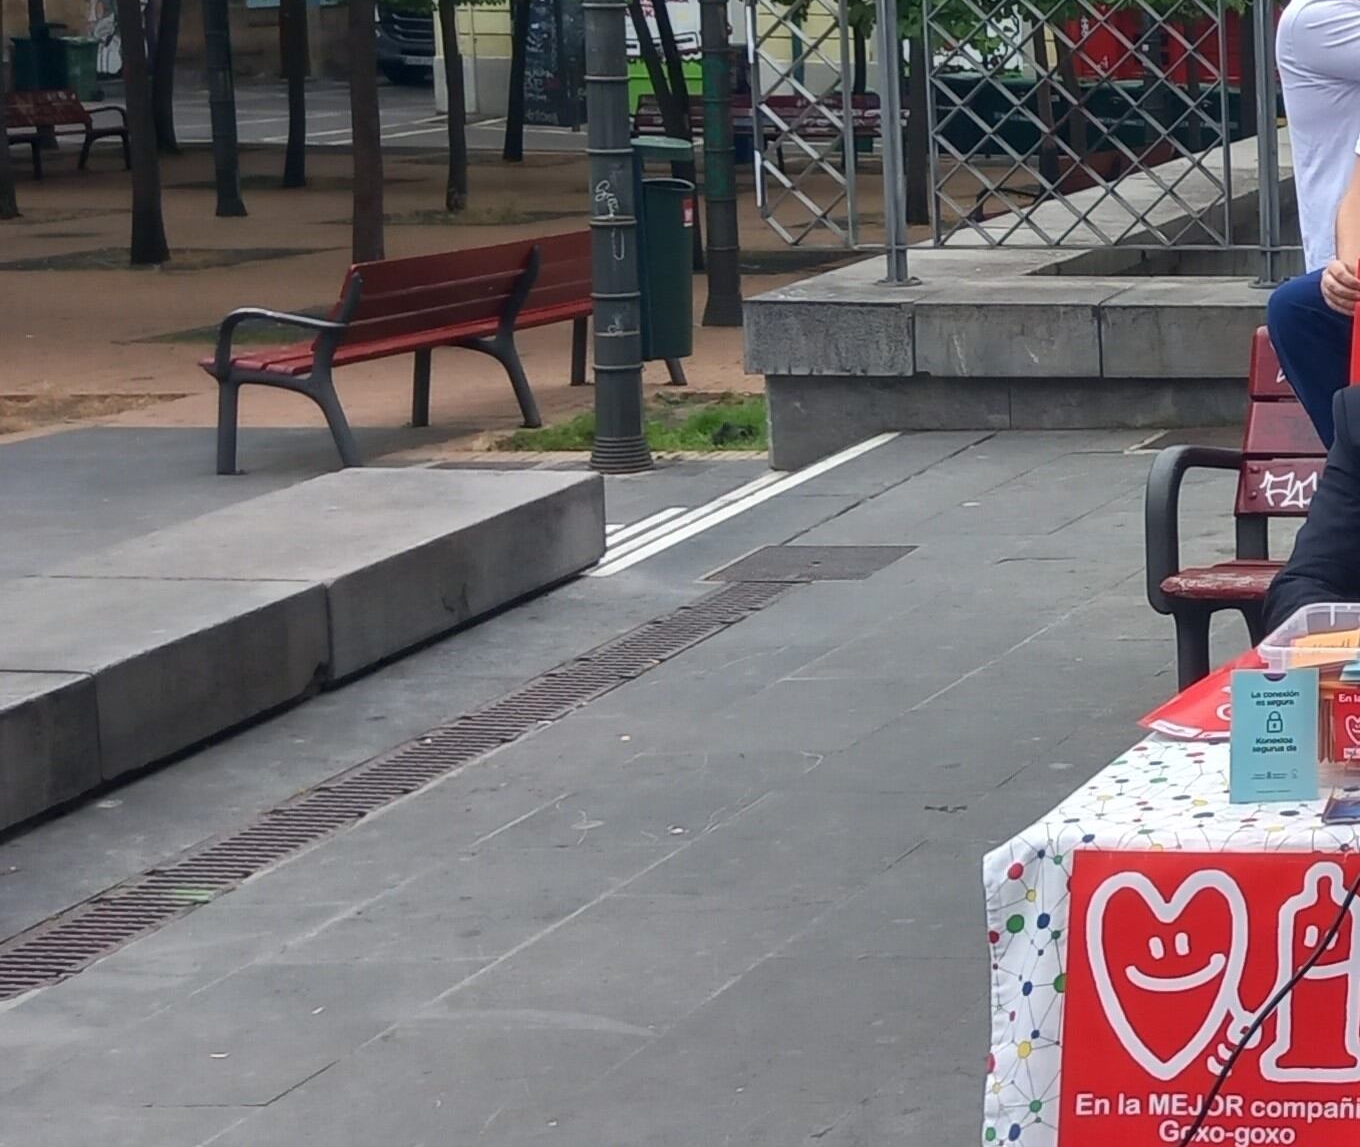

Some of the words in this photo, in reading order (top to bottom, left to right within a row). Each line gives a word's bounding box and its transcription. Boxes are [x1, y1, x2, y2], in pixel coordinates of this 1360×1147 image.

[1338, 694, 1352, 703] En
[1075, 1093, 1110, 1116] En
[1118, 1093, 1141, 1116] la
[1149, 1093, 1243, 1117] MEJOR
